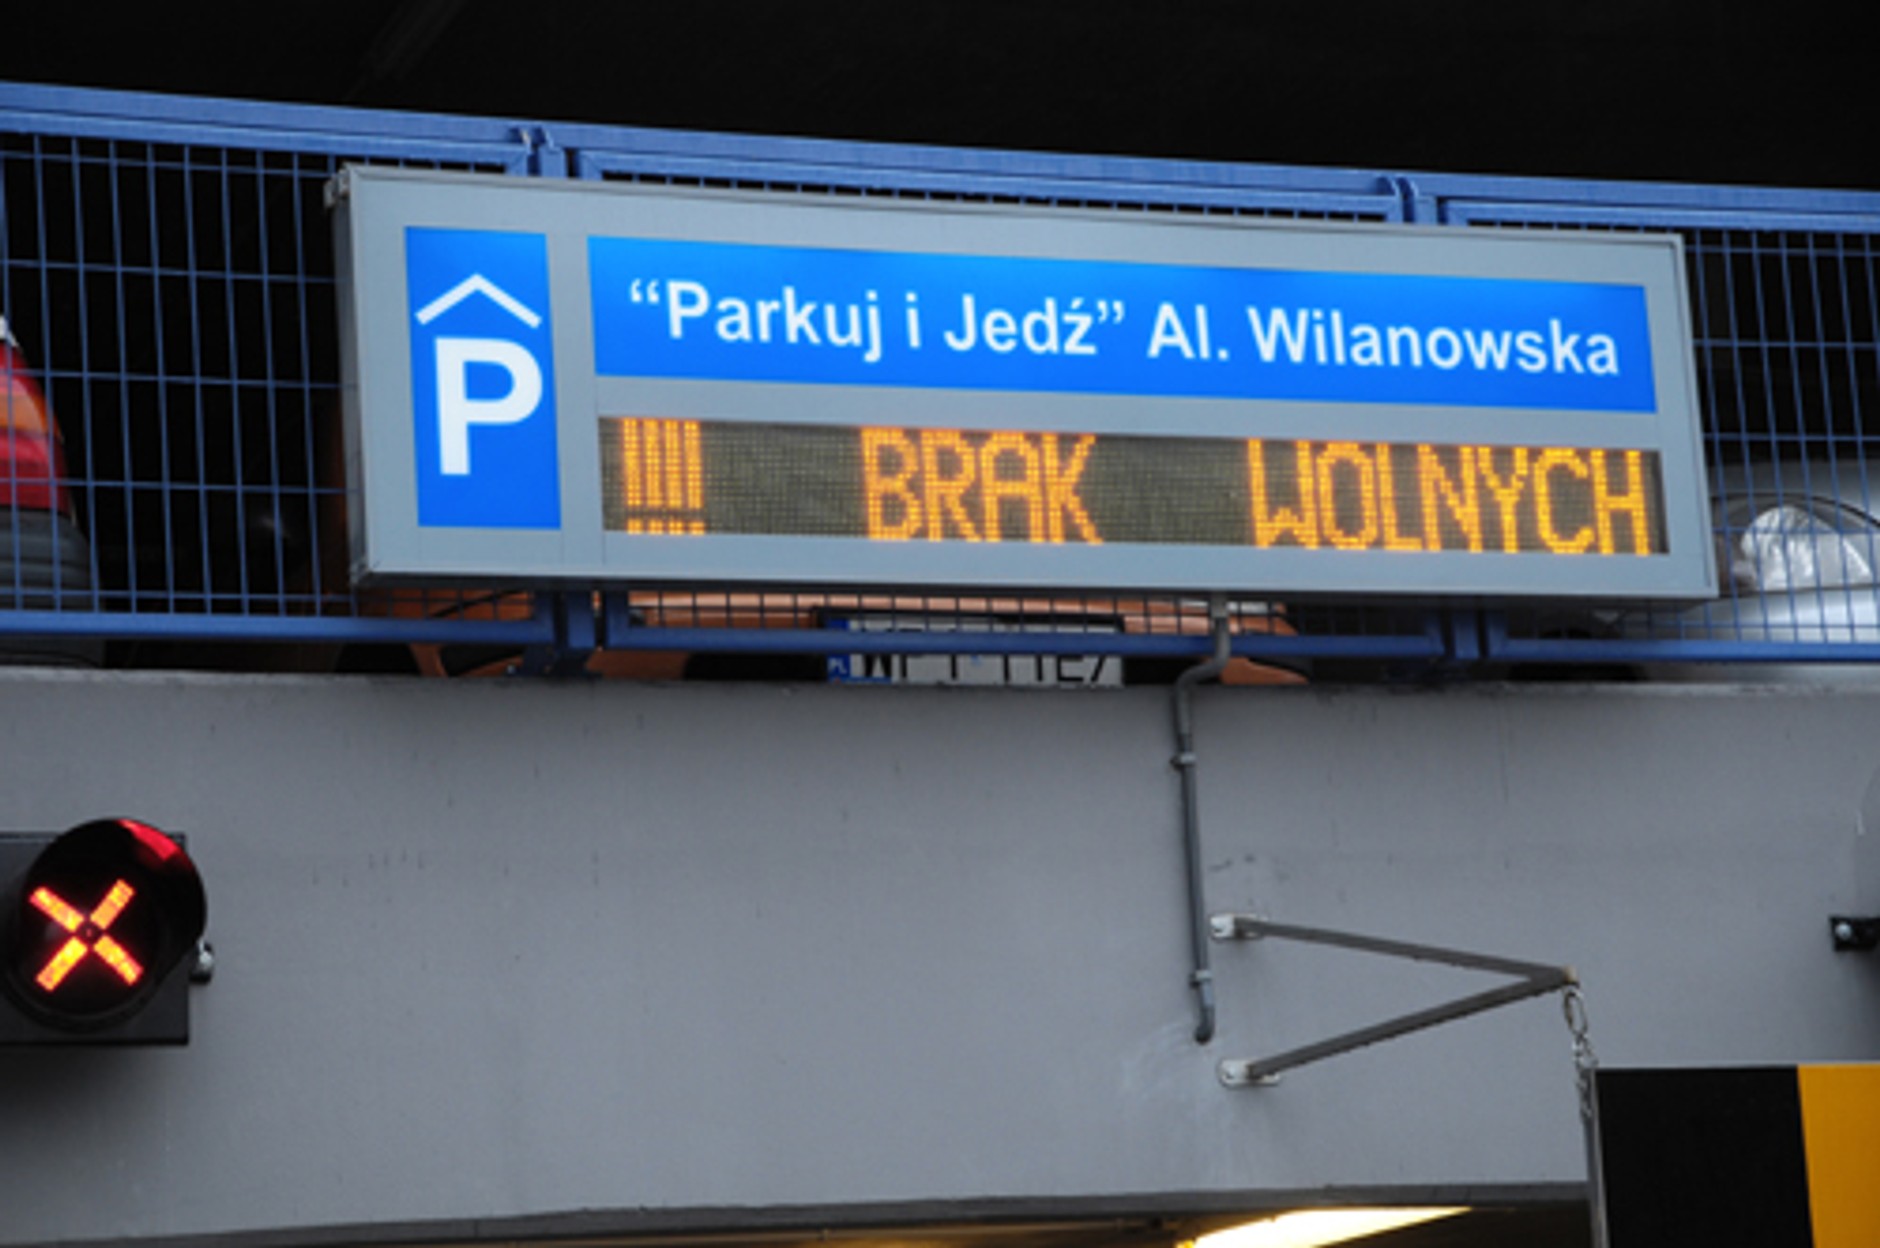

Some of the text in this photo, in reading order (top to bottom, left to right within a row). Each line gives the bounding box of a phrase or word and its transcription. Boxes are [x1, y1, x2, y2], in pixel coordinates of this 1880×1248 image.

[906, 293, 920, 348] i
[1147, 303, 1230, 360] Al.
[1247, 307, 1619, 375] Wilanowska
[434, 337, 542, 476] P
[861, 426, 1103, 544] BRAK
[1247, 438, 1650, 557] WOLNYCH
